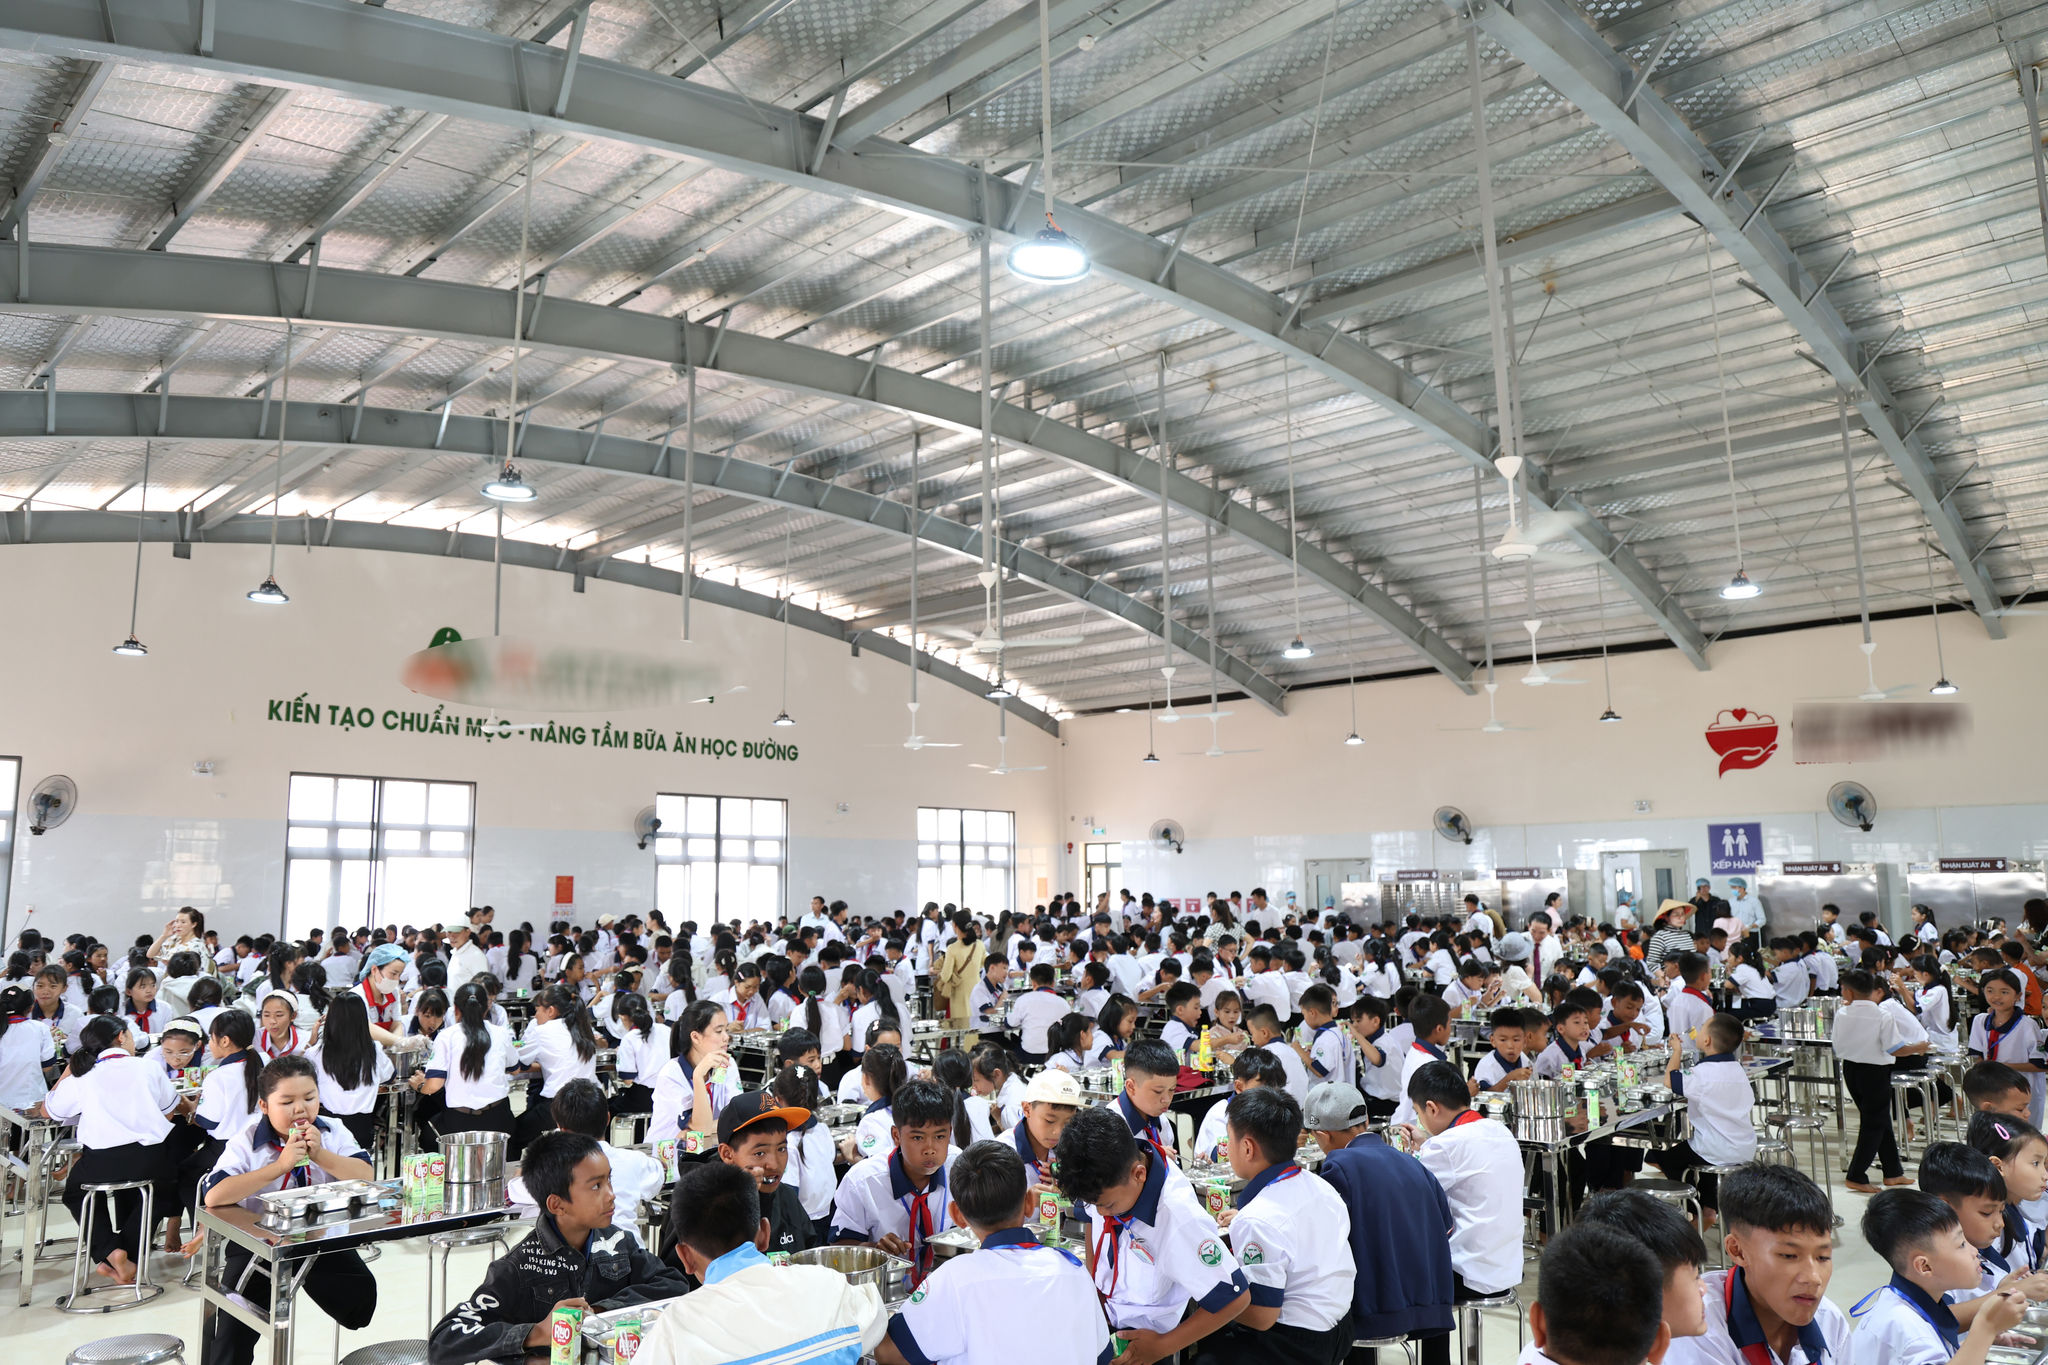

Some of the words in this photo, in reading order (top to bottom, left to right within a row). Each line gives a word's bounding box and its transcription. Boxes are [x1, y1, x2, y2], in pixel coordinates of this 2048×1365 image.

[268, 692, 320, 724] KIẾN
[328, 704, 374, 732] TẠO
[382, 704, 460, 736] CHUẨN
[530, 720, 586, 745] NÂNG
[591, 721, 628, 749] TẦM
[633, 728, 667, 751] BỮA
[673, 731, 696, 754] ĂN
[701, 738, 737, 760] HỌC
[742, 737, 799, 761] ĐƯỜNG
[1712, 858, 1732, 870] XẾP
